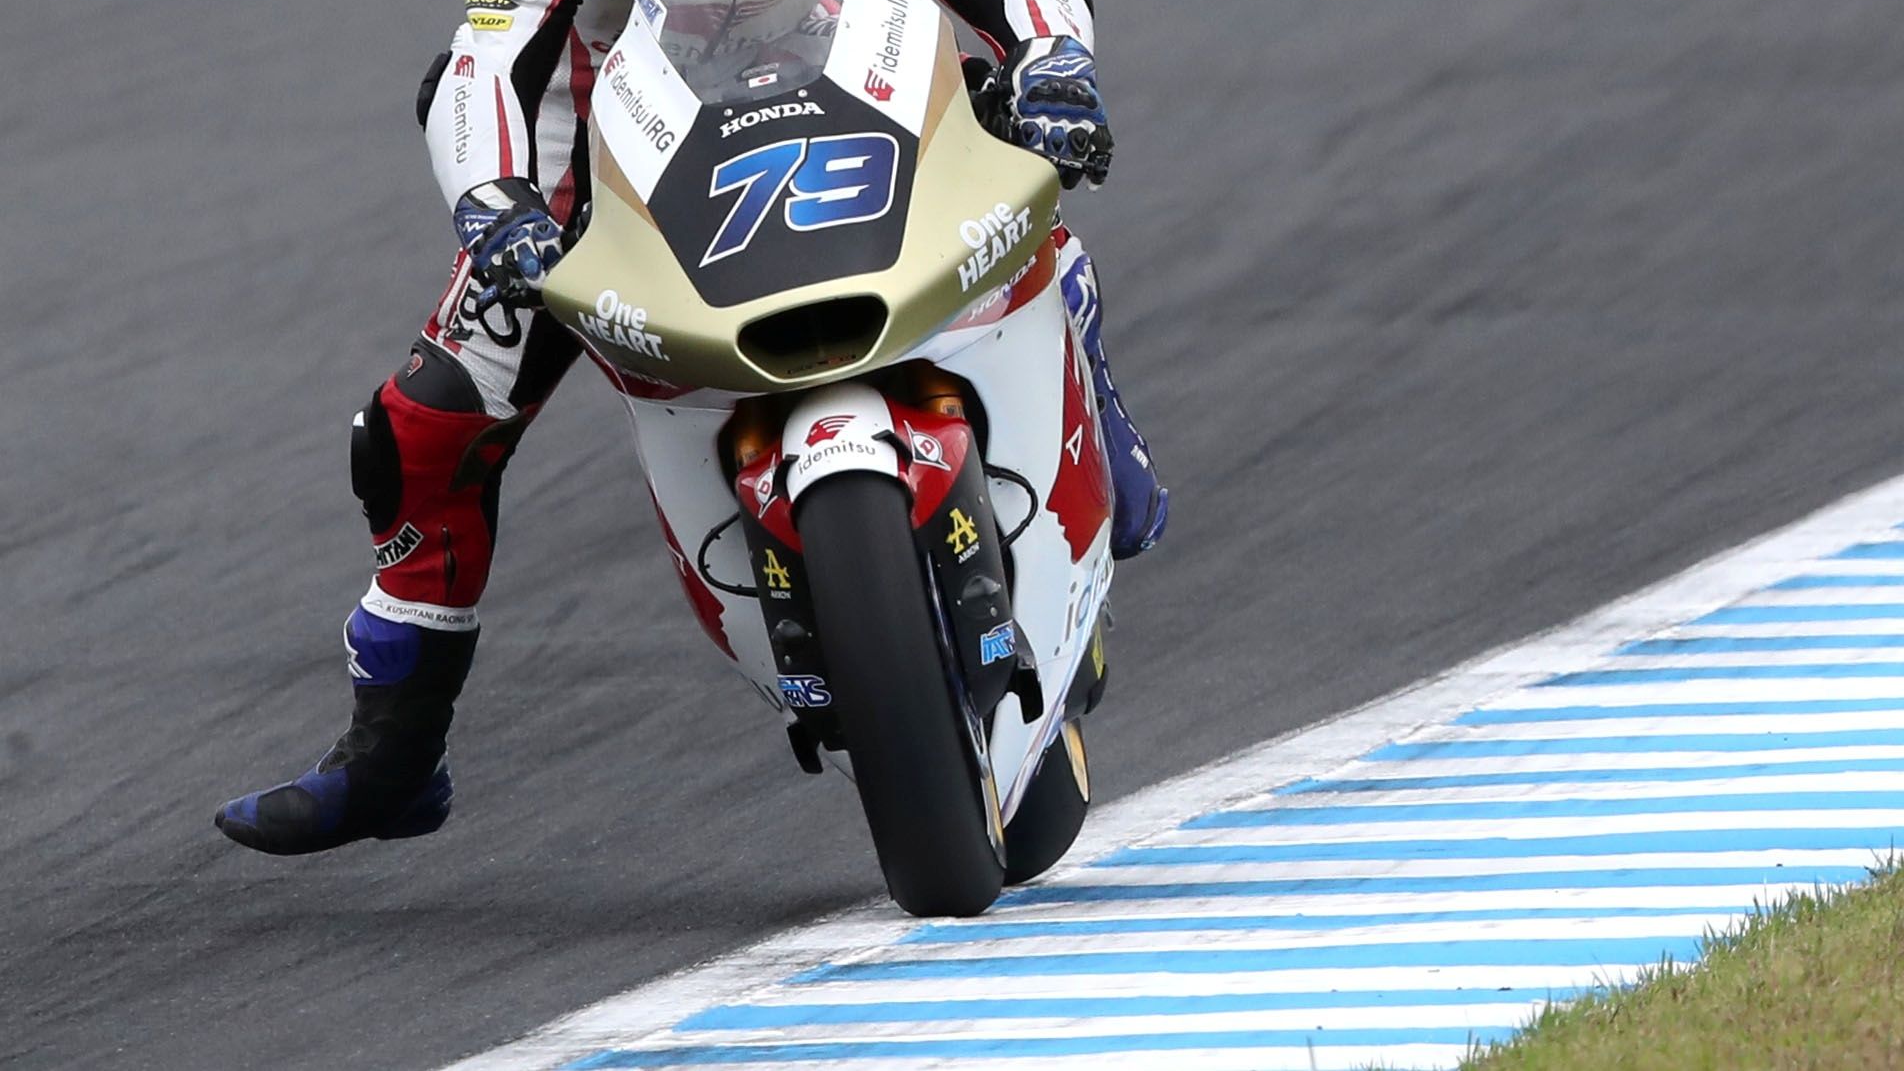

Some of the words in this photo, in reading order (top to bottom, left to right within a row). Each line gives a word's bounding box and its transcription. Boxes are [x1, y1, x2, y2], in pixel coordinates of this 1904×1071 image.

[454, 81, 473, 164] idemitsu
[719, 101, 826, 139] HONDA
[699, 131, 901, 269] 79
[959, 201, 1015, 250] One
[957, 206, 1033, 293] HEART.
[595, 289, 648, 330] One
[577, 311, 671, 362] HEART.
[799, 440, 877, 475] idemitsu
[376, 524, 421, 567] HITANI
[386, 604, 435, 621] KUSHITANI
[435, 615, 466, 625] RACING
